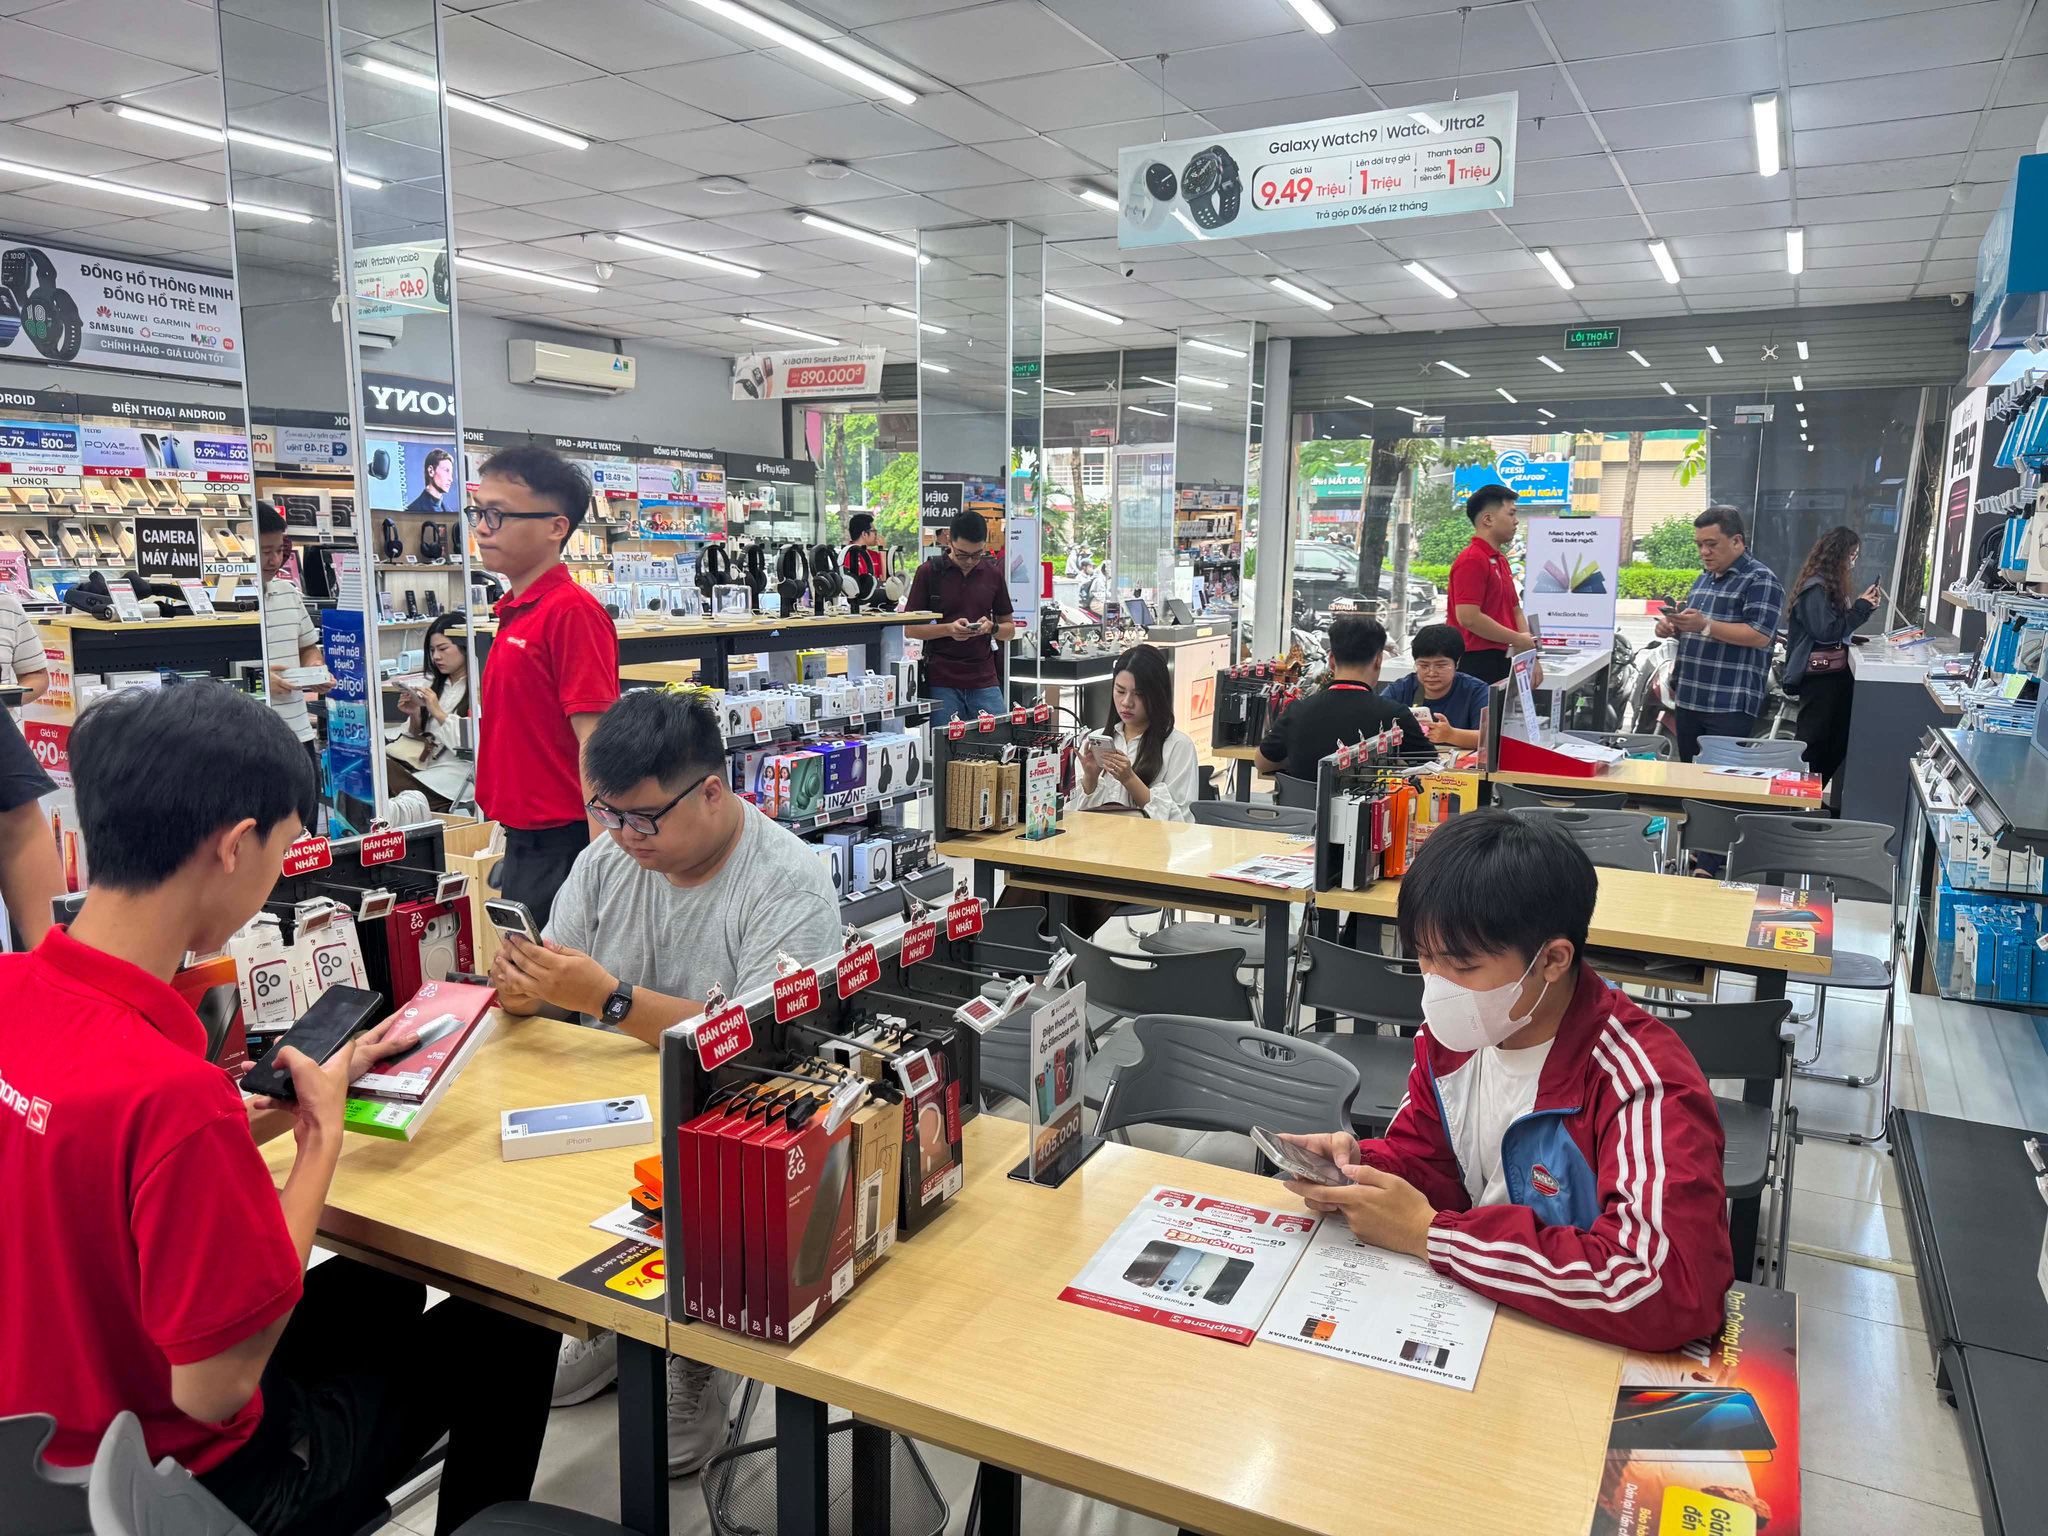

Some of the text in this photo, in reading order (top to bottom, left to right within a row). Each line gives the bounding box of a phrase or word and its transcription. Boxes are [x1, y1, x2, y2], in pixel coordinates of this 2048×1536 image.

[1268, 127, 1378, 156] Galaxy Watch9
[1427, 146, 1473, 159] Thanh toán
[1355, 159, 1370, 168] Lên
[1398, 153, 1411, 165] giá
[1289, 165, 1313, 175] Giá từ
[1424, 165, 1442, 174] Hoàn
[1447, 159, 1491, 185] 1 Triệu
[1360, 170, 1402, 195] 1 Triệu
[1261, 176, 1313, 207] 9.49
[1316, 182, 1346, 198] Triệu
[1315, 200, 1429, 222] Trả góp 0% đến 12 tháng
[80, 262, 234, 301] ĐỒNG HỒ THÔNG MINH
[103, 286, 218, 316] ĐỒNG HỒ TRẺ EM
[113, 311, 148, 323] HUAWEI
[153, 317, 191, 329] GARMIN
[89, 321, 134, 335] SAMSUNG
[195, 322, 221, 333] imoo
[151, 331, 185, 341] COROS
[1586, 330, 1614, 341] THOÁT
[100, 338, 224, 363] CHÍNH HÃNG GIÁ LUÔN TỐT
[782, 357, 812, 366] xiaomi
[800, 367, 862, 385] 890.000đ
[112, 402, 227, 421] ĐIỆN THOẠI ANDROID
[84, 440, 118, 449] POVA
[555, 439, 621, 452] IPAD APPLE WATCH
[1951, 420, 1977, 479] PRO
[195, 447, 216, 458] 9.99
[699, 452, 714, 460] MINH
[604, 472, 621, 481] 18.49
[762, 463, 790, 476] Phụ Kiện
[1500, 466, 1525, 475] FRESH
[13, 477, 49, 486] HONOR
[204, 482, 240, 493] oppo
[142, 529, 196, 545] CAMERA
[142, 548, 198, 567] MÁY ẢNH
[205, 563, 249, 573] xiaomi
[40, 728, 59, 739] Giá từ
[1029, 767, 1055, 777] S-Financing
[302, 842, 326, 857] CHẠY
[363, 836, 403, 851] BÁN CHẠY
[372, 848, 394, 860] NHẤT
[295, 855, 319, 871] NHẤT
[948, 903, 979, 922] BÁN CHẠY
[955, 918, 973, 933] NHẤT
[904, 927, 935, 948] BÁN CHẠY
[908, 944, 926, 960] NHẤT
[838, 951, 874, 978] BÁN CHẠY
[776, 973, 815, 1000] BÁN CHẠY
[848, 970, 869, 990] NHẤT
[786, 994, 809, 1014] NHẤT
[698, 1011, 745, 1047] BÁN CHẠY
[1055, 1015, 1067, 1032] thoại
[1048, 1028, 1069, 1049] Slimcase
[713, 1035, 740, 1060] NHẤT
[566, 1137, 592, 1146] iPhone
[1038, 1116, 1080, 1162] 405.000
[1142, 1291, 1155, 1299] Pro
[1164, 1296, 1189, 1308] iPhone
[1268, 1330, 1288, 1339] MAX
[1718, 1290, 1746, 1367] Dán Cường Lực
[1287, 1334, 1303, 1342] PRO
[1312, 1341, 1344, 1352] IPHONE
[1350, 1349, 1371, 1359] MAX
[1371, 1355, 1388, 1363] PRO
[1398, 1361, 1430, 1372] IPHONE
[1430, 1369, 1454, 1379] SÁNH
[1625, 1483, 1639, 1499] Dán
[1621, 1499, 1635, 1510] lại
[1620, 1513, 1632, 1527] lần
[1638, 1508, 1652, 1522] Bảo
[1682, 1505, 1706, 1531] đến
